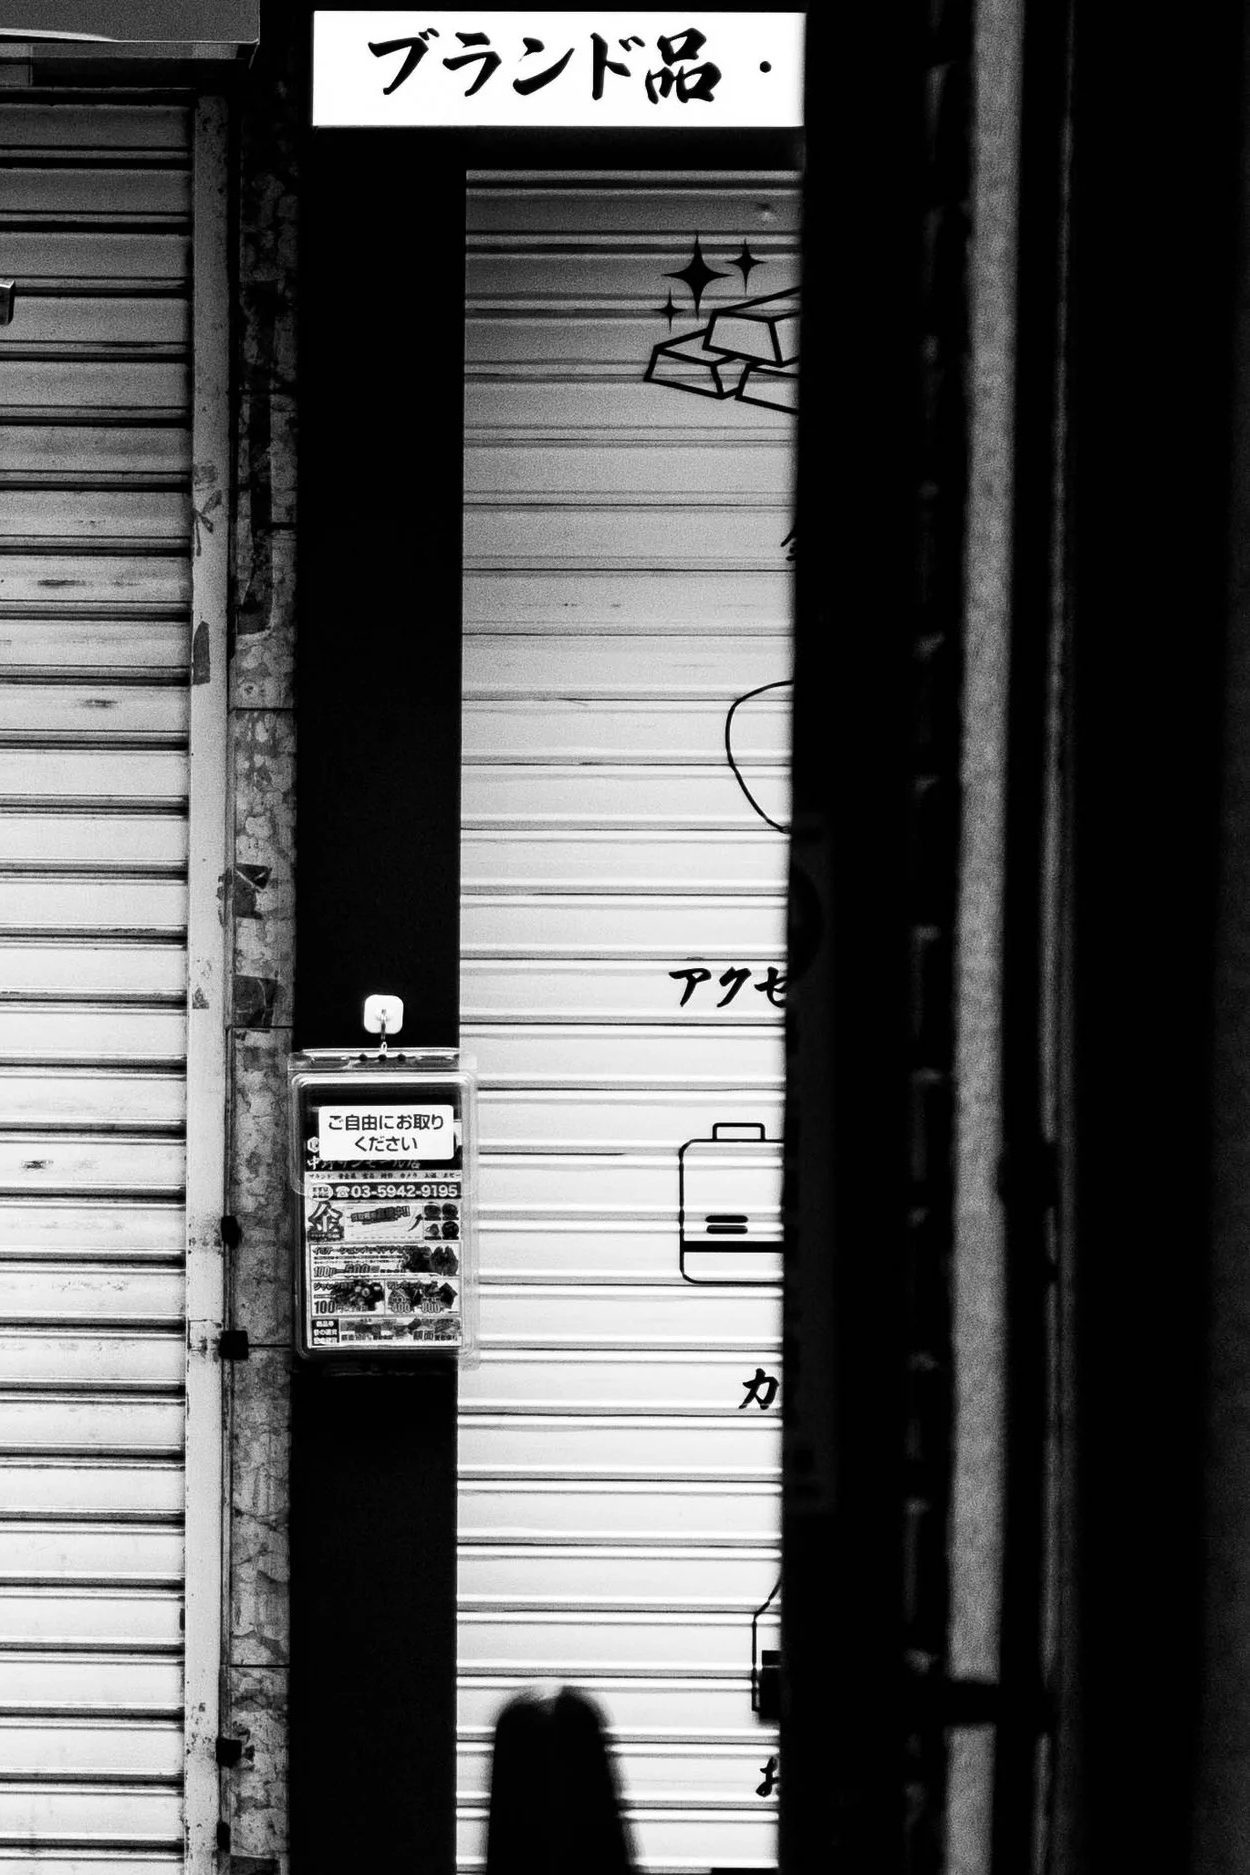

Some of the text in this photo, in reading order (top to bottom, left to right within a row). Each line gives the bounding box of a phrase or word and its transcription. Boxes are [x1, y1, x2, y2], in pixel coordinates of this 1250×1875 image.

[328, 1113, 444, 1131] ご自由にお取り
[354, 1135, 418, 1152] ください
[351, 1184, 458, 1198] 03-5942-9195
